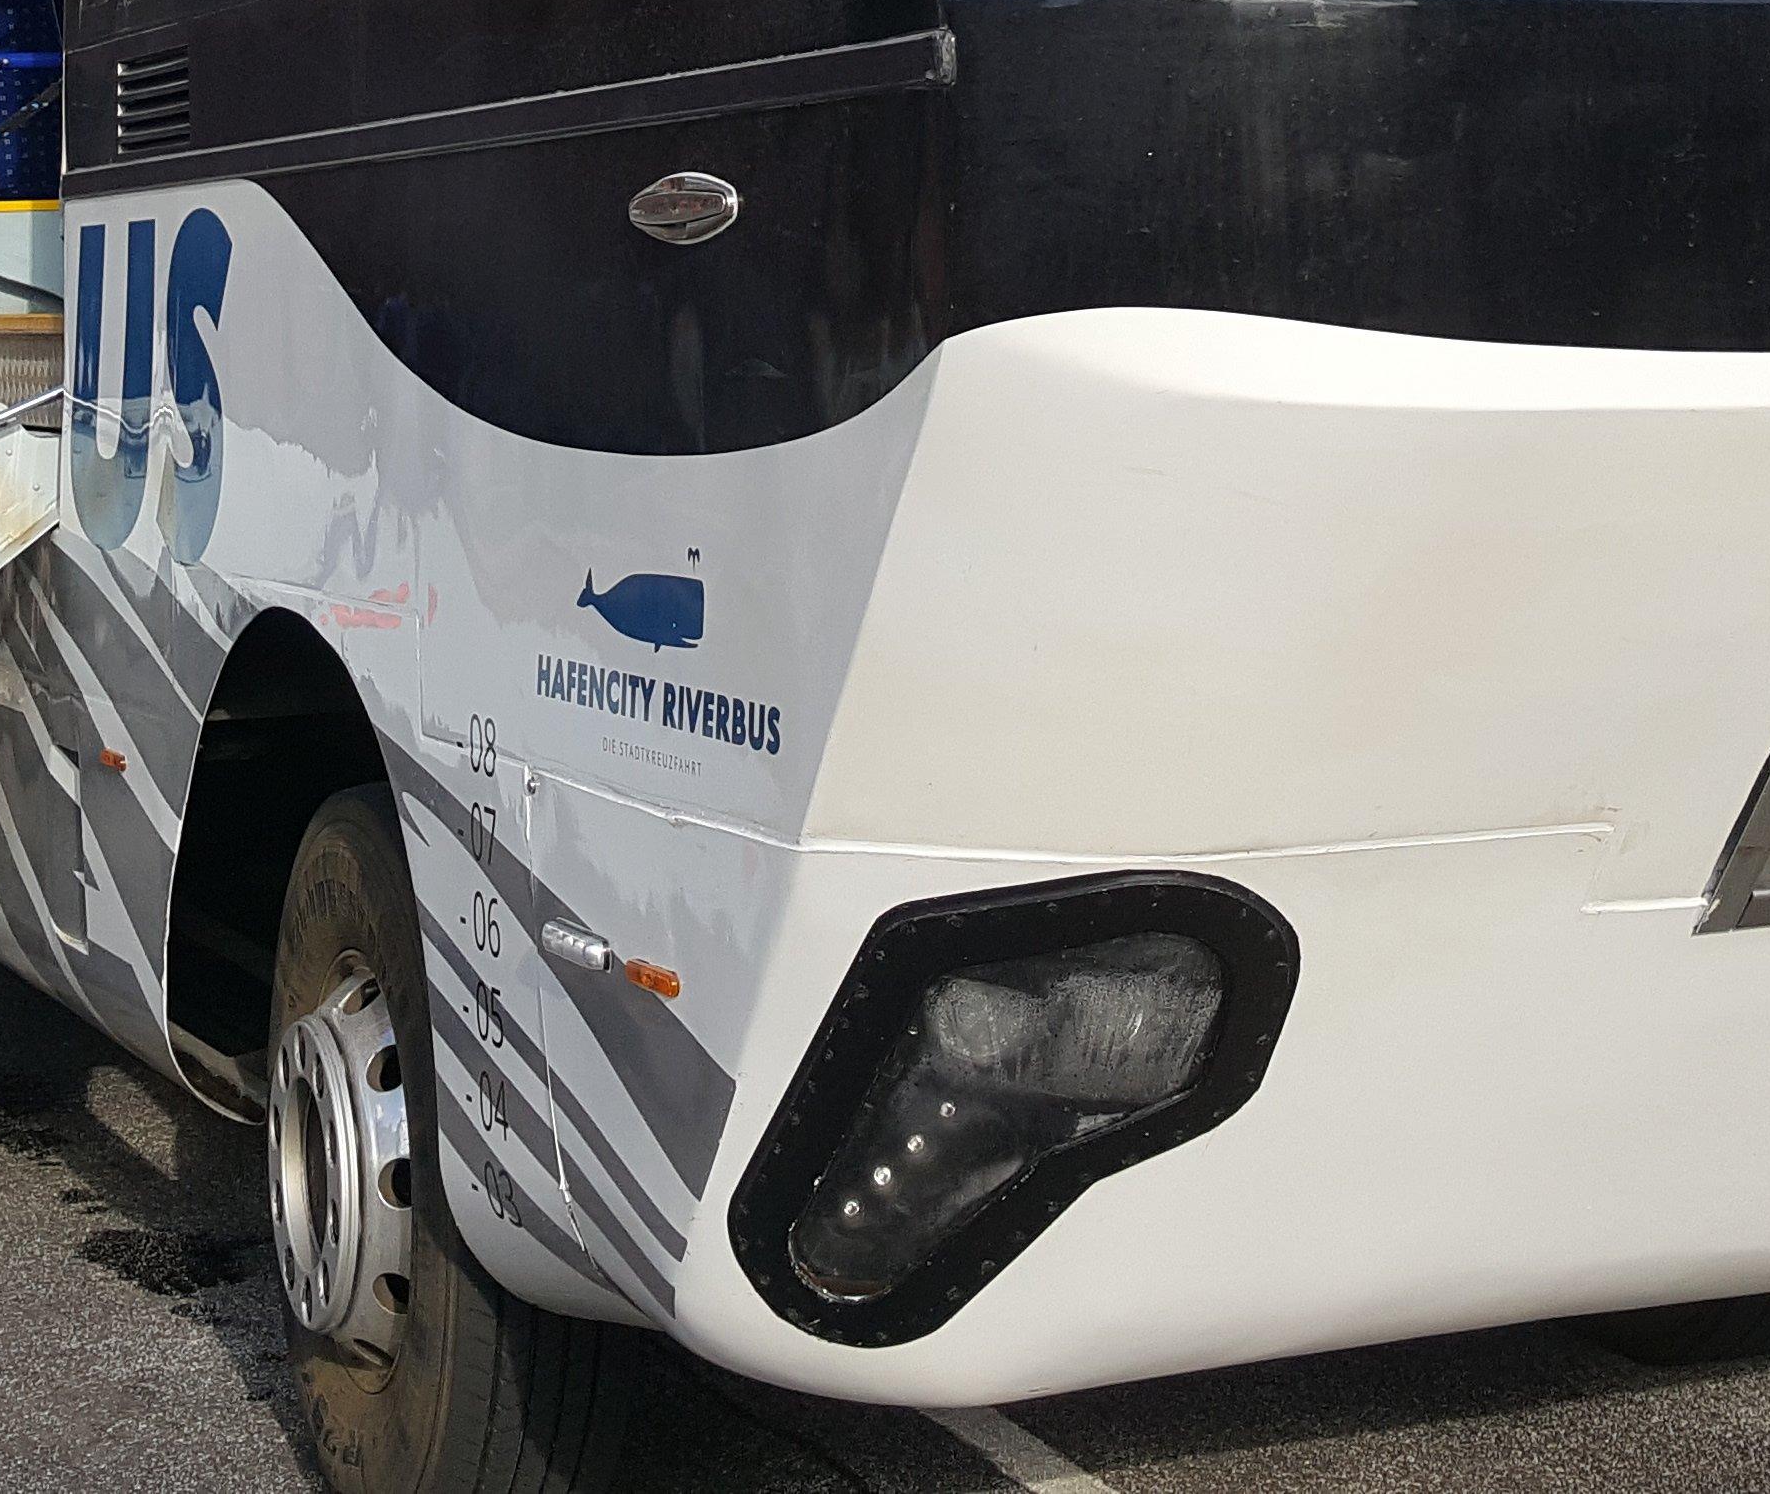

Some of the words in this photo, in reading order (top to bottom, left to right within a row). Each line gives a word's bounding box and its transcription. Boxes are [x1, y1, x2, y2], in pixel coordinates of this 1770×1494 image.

[536, 653, 657, 723] HAFENCITY
[662, 681, 781, 756] RIVERBUS
[602, 736, 616, 755] DIE
[619, 741, 702, 777] STADTKREUZFAHRT
